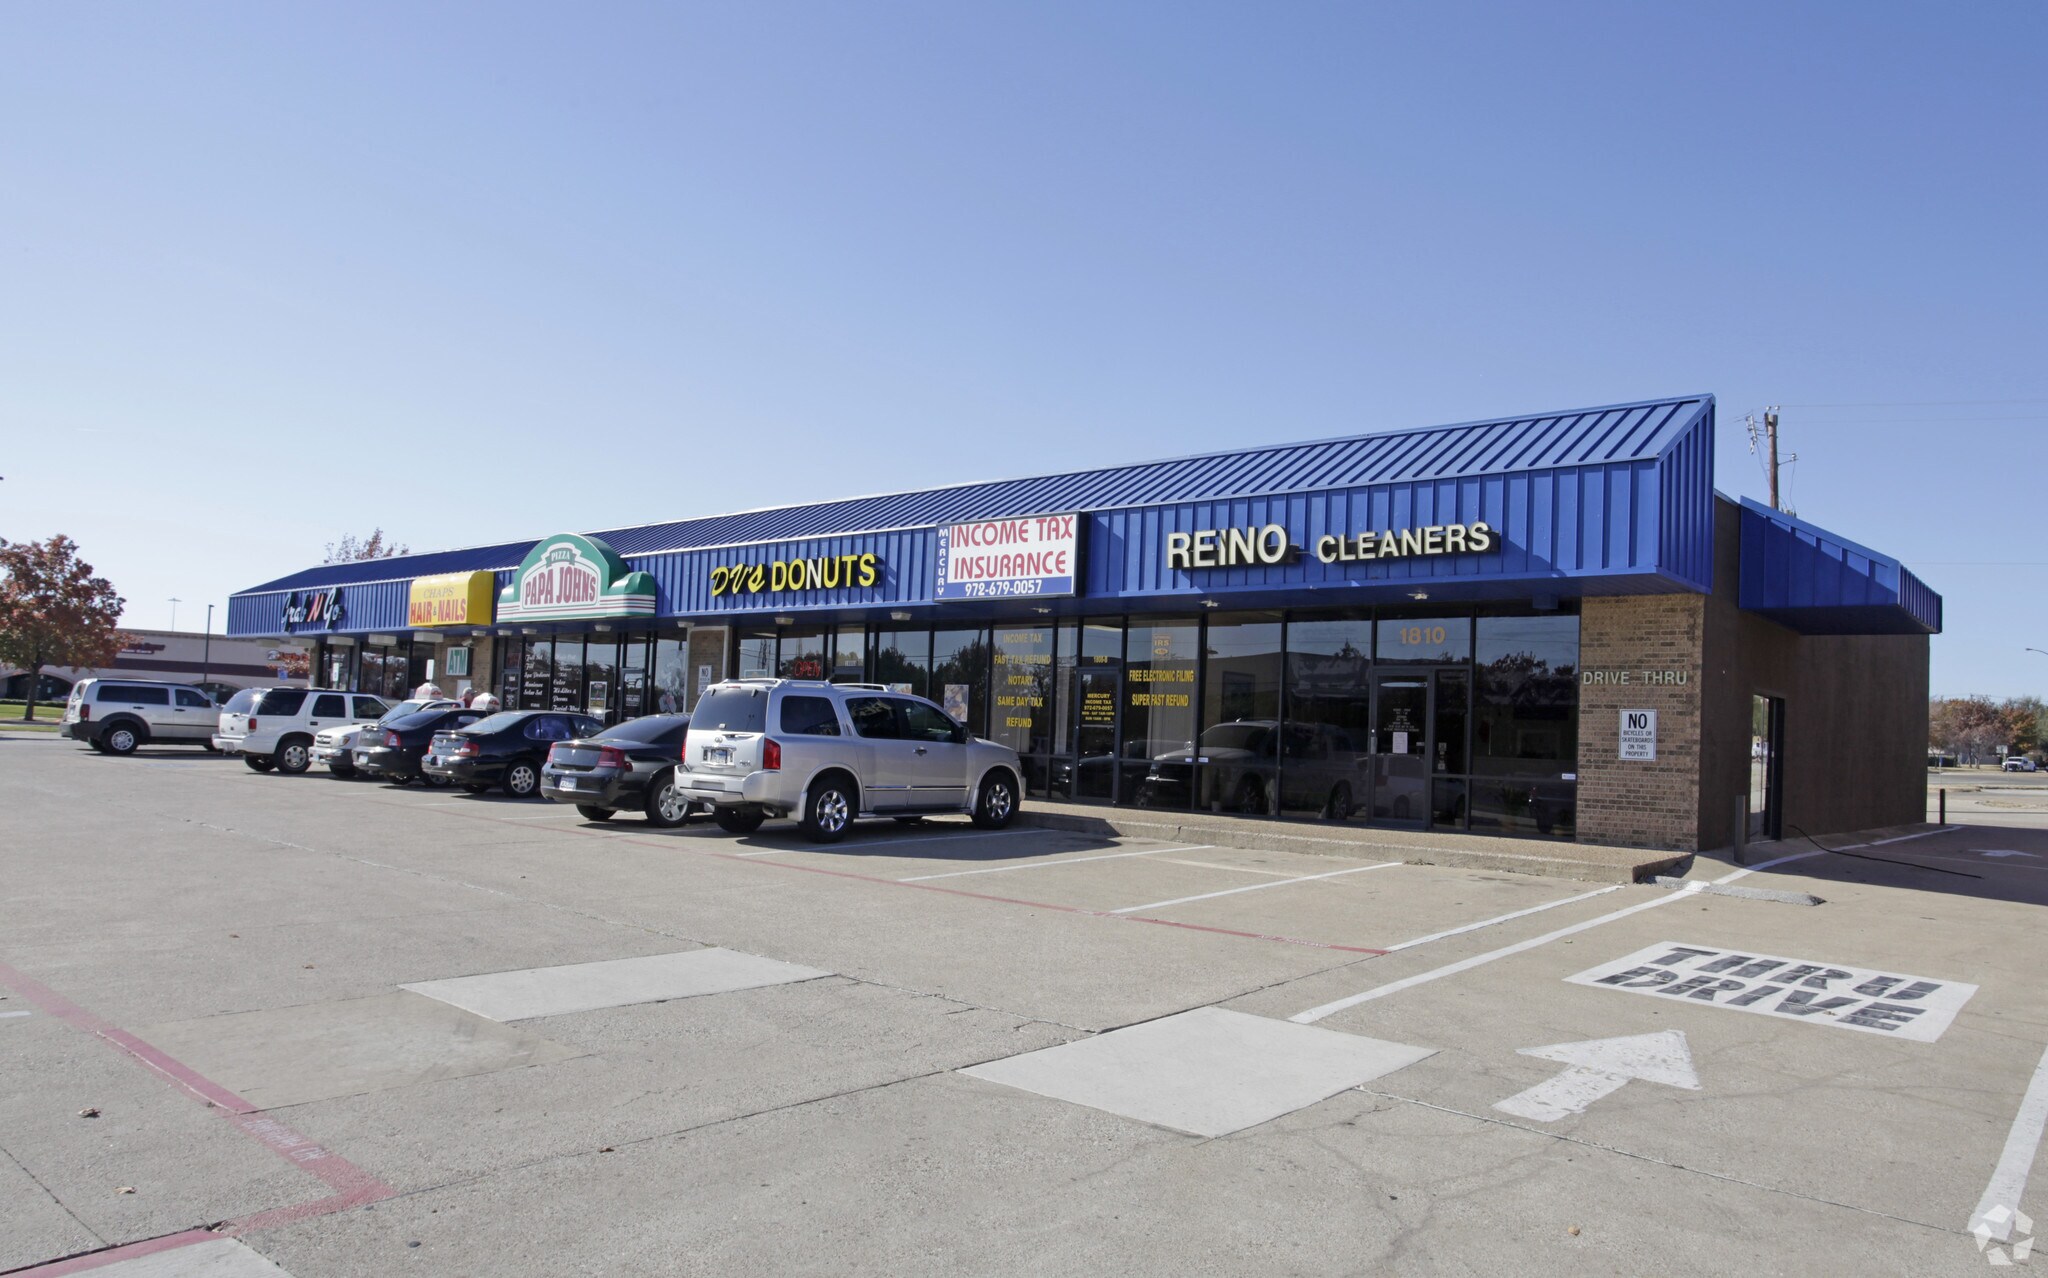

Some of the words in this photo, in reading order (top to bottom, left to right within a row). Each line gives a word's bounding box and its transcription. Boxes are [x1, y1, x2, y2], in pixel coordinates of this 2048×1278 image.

[950, 520, 1029, 548] INCOME
[1036, 515, 1073, 542] TAX
[1167, 523, 1288, 569] REINO
[1317, 521, 1492, 564] CLEANERS
[551, 550, 570, 561] PIZZA
[938, 528, 949, 596] MERCURY
[771, 552, 876, 592] DONUTS
[954, 550, 1066, 580] INSURANCE
[423, 587, 454, 599] CHAPS
[525, 568, 554, 606] PAPA
[965, 579, 1042, 597] 972-679-0057
[410, 601, 433, 624] HAIR
[438, 599, 466, 622] NAILS
[1003, 633, 1028, 643] INCOME
[1030, 633, 1042, 643] TAX
[1154, 639, 1169, 647] IRS
[1400, 626, 1446, 645] 1810
[449, 649, 468, 675] ATM
[994, 654, 1009, 664] FAST
[1023, 654, 1051, 664] REFUND
[794, 660, 821, 678] OPEN
[1129, 669, 1143, 681] FREE
[1143, 669, 1176, 682] ELECTRONIC
[1176, 669, 1194, 682] FILING
[1583, 671, 1630, 685] DRIVE
[1642, 670, 1687, 685] THRU
[1008, 675, 1034, 685] NOTARY
[998, 695, 1015, 706] SAME
[1016, 696, 1029, 706] DAY
[1030, 697, 1043, 707] TAX
[1132, 693, 1150, 705] SUPER
[1151, 694, 1165, 705] FAST
[1166, 694, 1189, 706] REFUND
[1006, 717, 1032, 728] REFUND
[1627, 713, 1648, 729] NO
[1648, 946, 1944, 1001] THRU
[1593, 965, 1928, 1031] DRIVE
